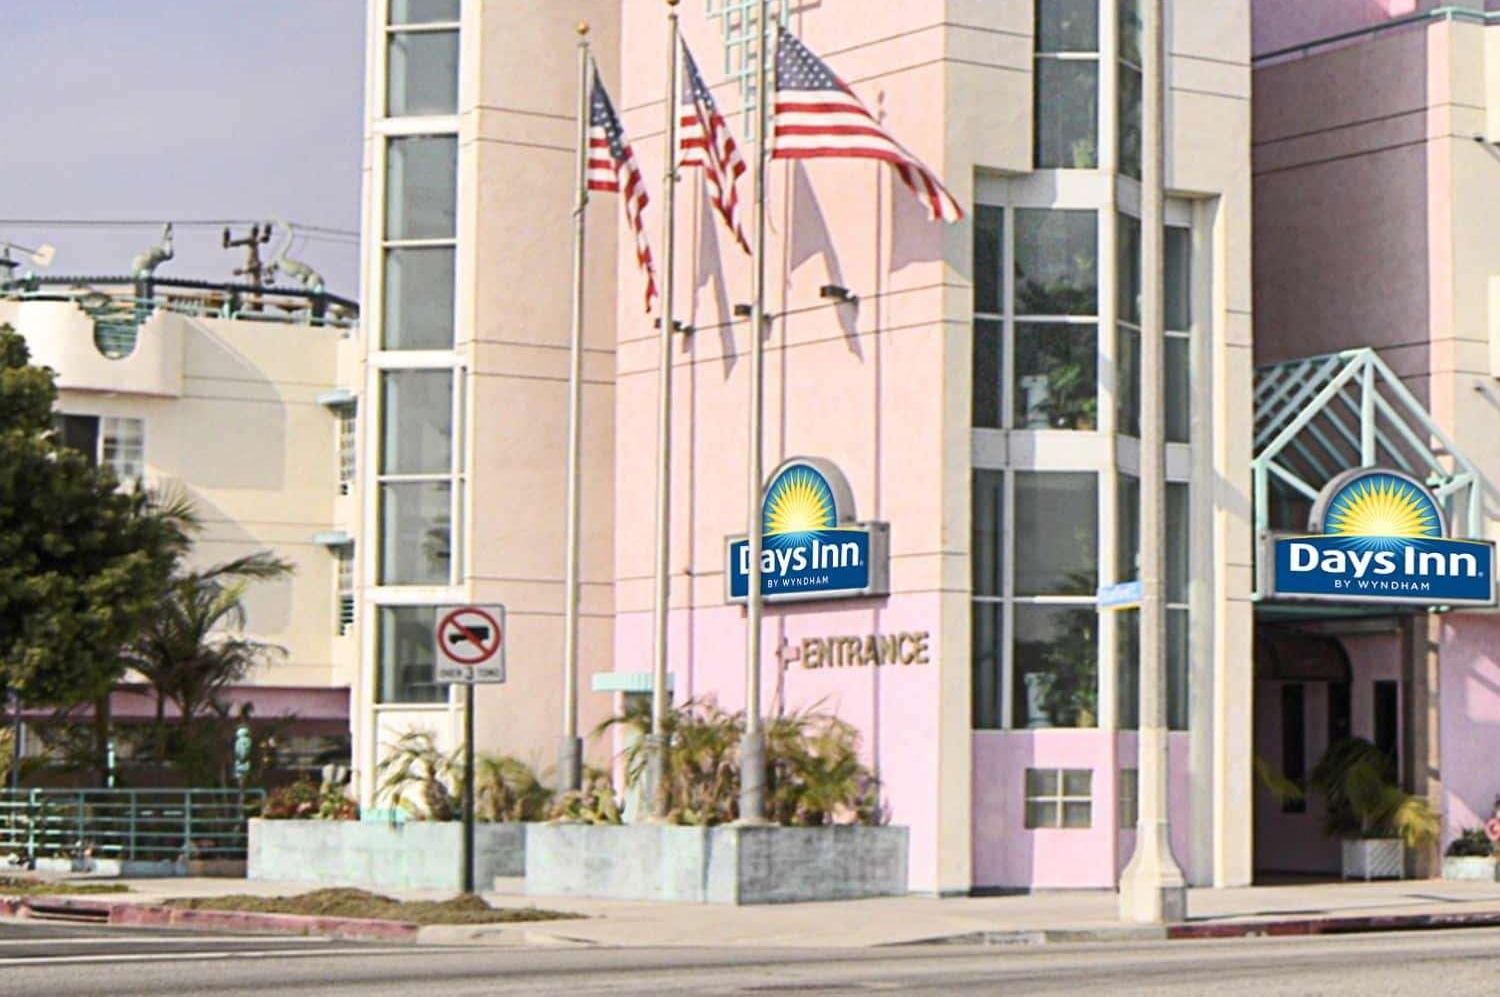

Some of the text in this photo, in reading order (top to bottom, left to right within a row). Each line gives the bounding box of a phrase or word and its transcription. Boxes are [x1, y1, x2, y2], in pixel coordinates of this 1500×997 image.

[812, 540, 859, 569] Inn
[1290, 543, 1477, 577] Days Inn
[767, 576, 829, 588] BY WYNDHAM
[1334, 579, 1431, 591] BY WYNDHAM
[801, 631, 930, 669] ENTRANCE
